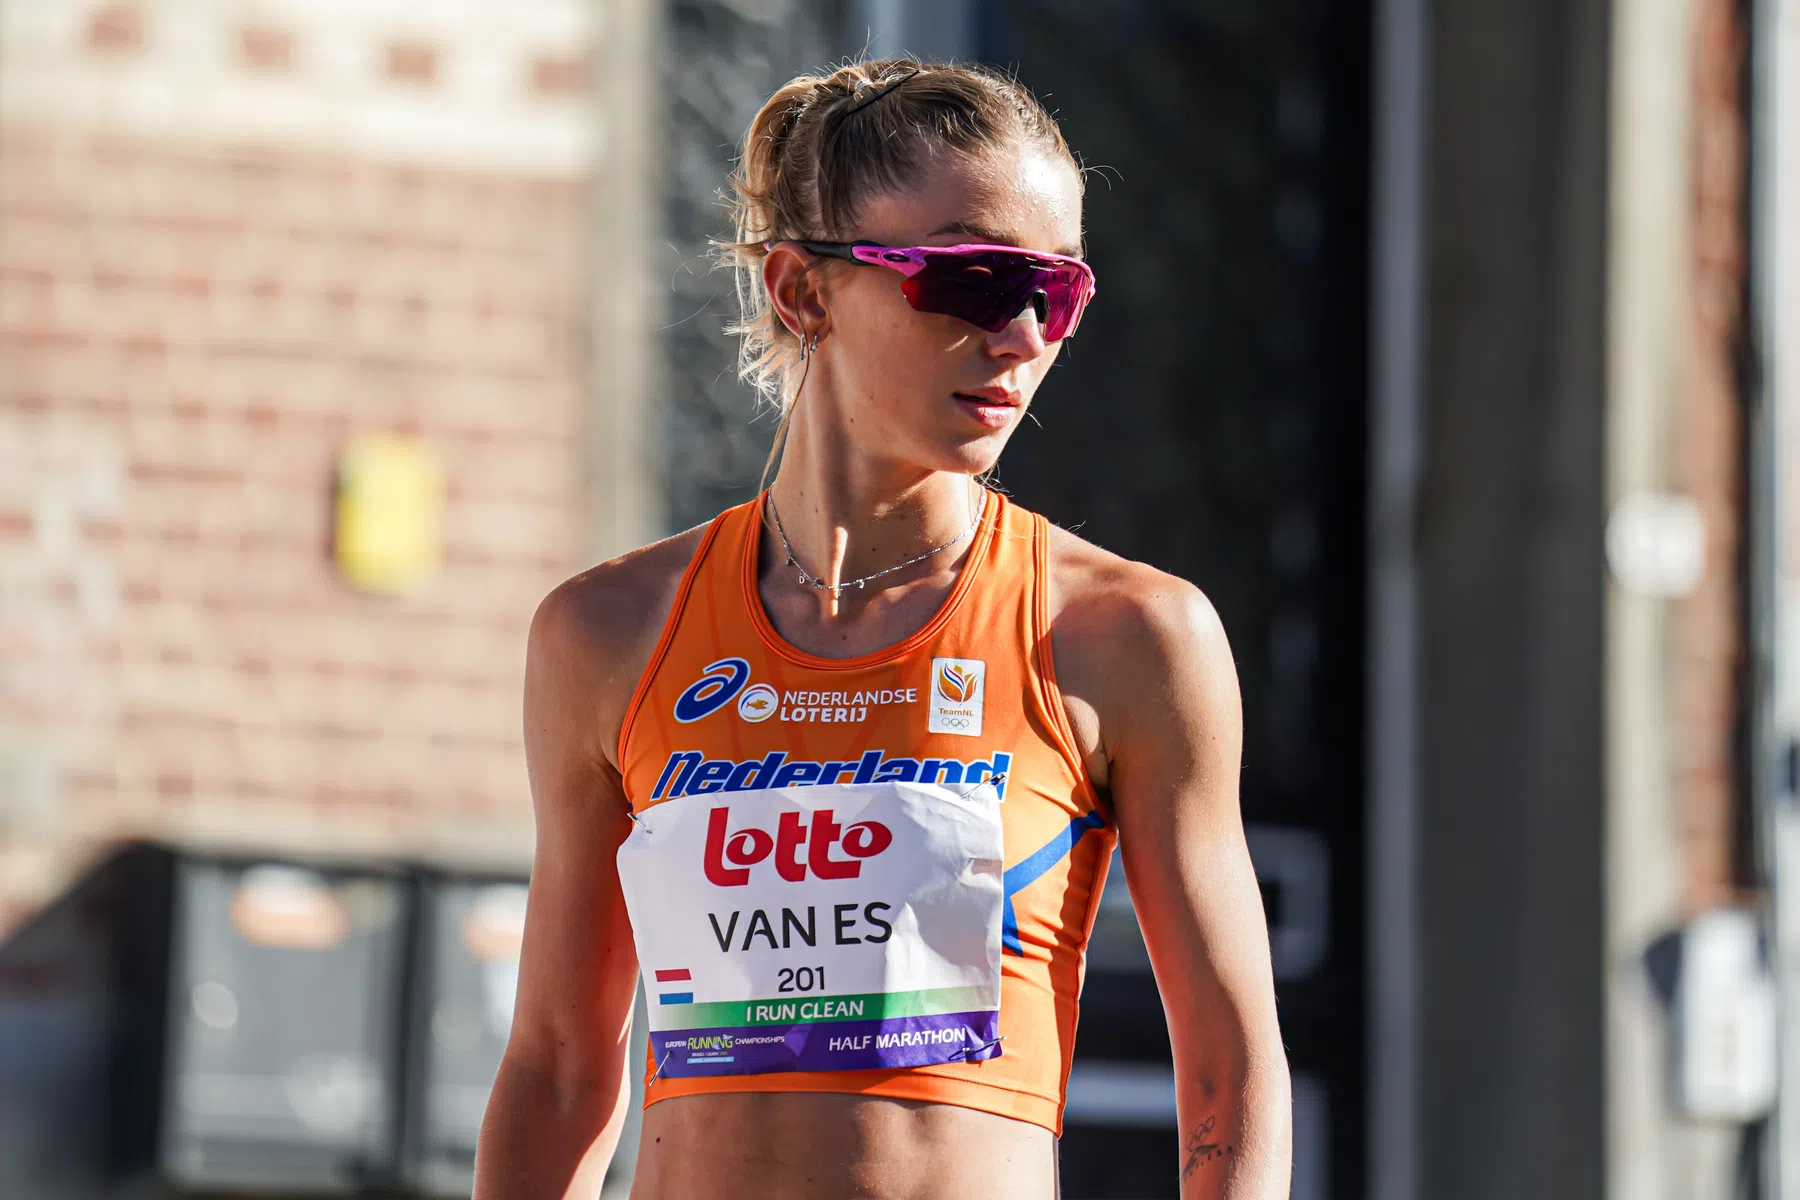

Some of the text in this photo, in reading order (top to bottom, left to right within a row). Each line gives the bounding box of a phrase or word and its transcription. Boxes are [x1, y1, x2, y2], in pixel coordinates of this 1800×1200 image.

[783, 688, 917, 706] NEDERLANDSE
[780, 706, 867, 723] LOTERIJ
[939, 707, 974, 717] TeamNL
[708, 901, 893, 952] VAN ES
[777, 966, 826, 992] 201
[755, 1003, 796, 1021] RUN
[799, 1000, 864, 1019] CLEAN
[687, 1034, 734, 1051] RUNNING
[735, 1035, 785, 1045] CHAMPIONSHIPS
[829, 1027, 966, 1051] HALF MARATHON
